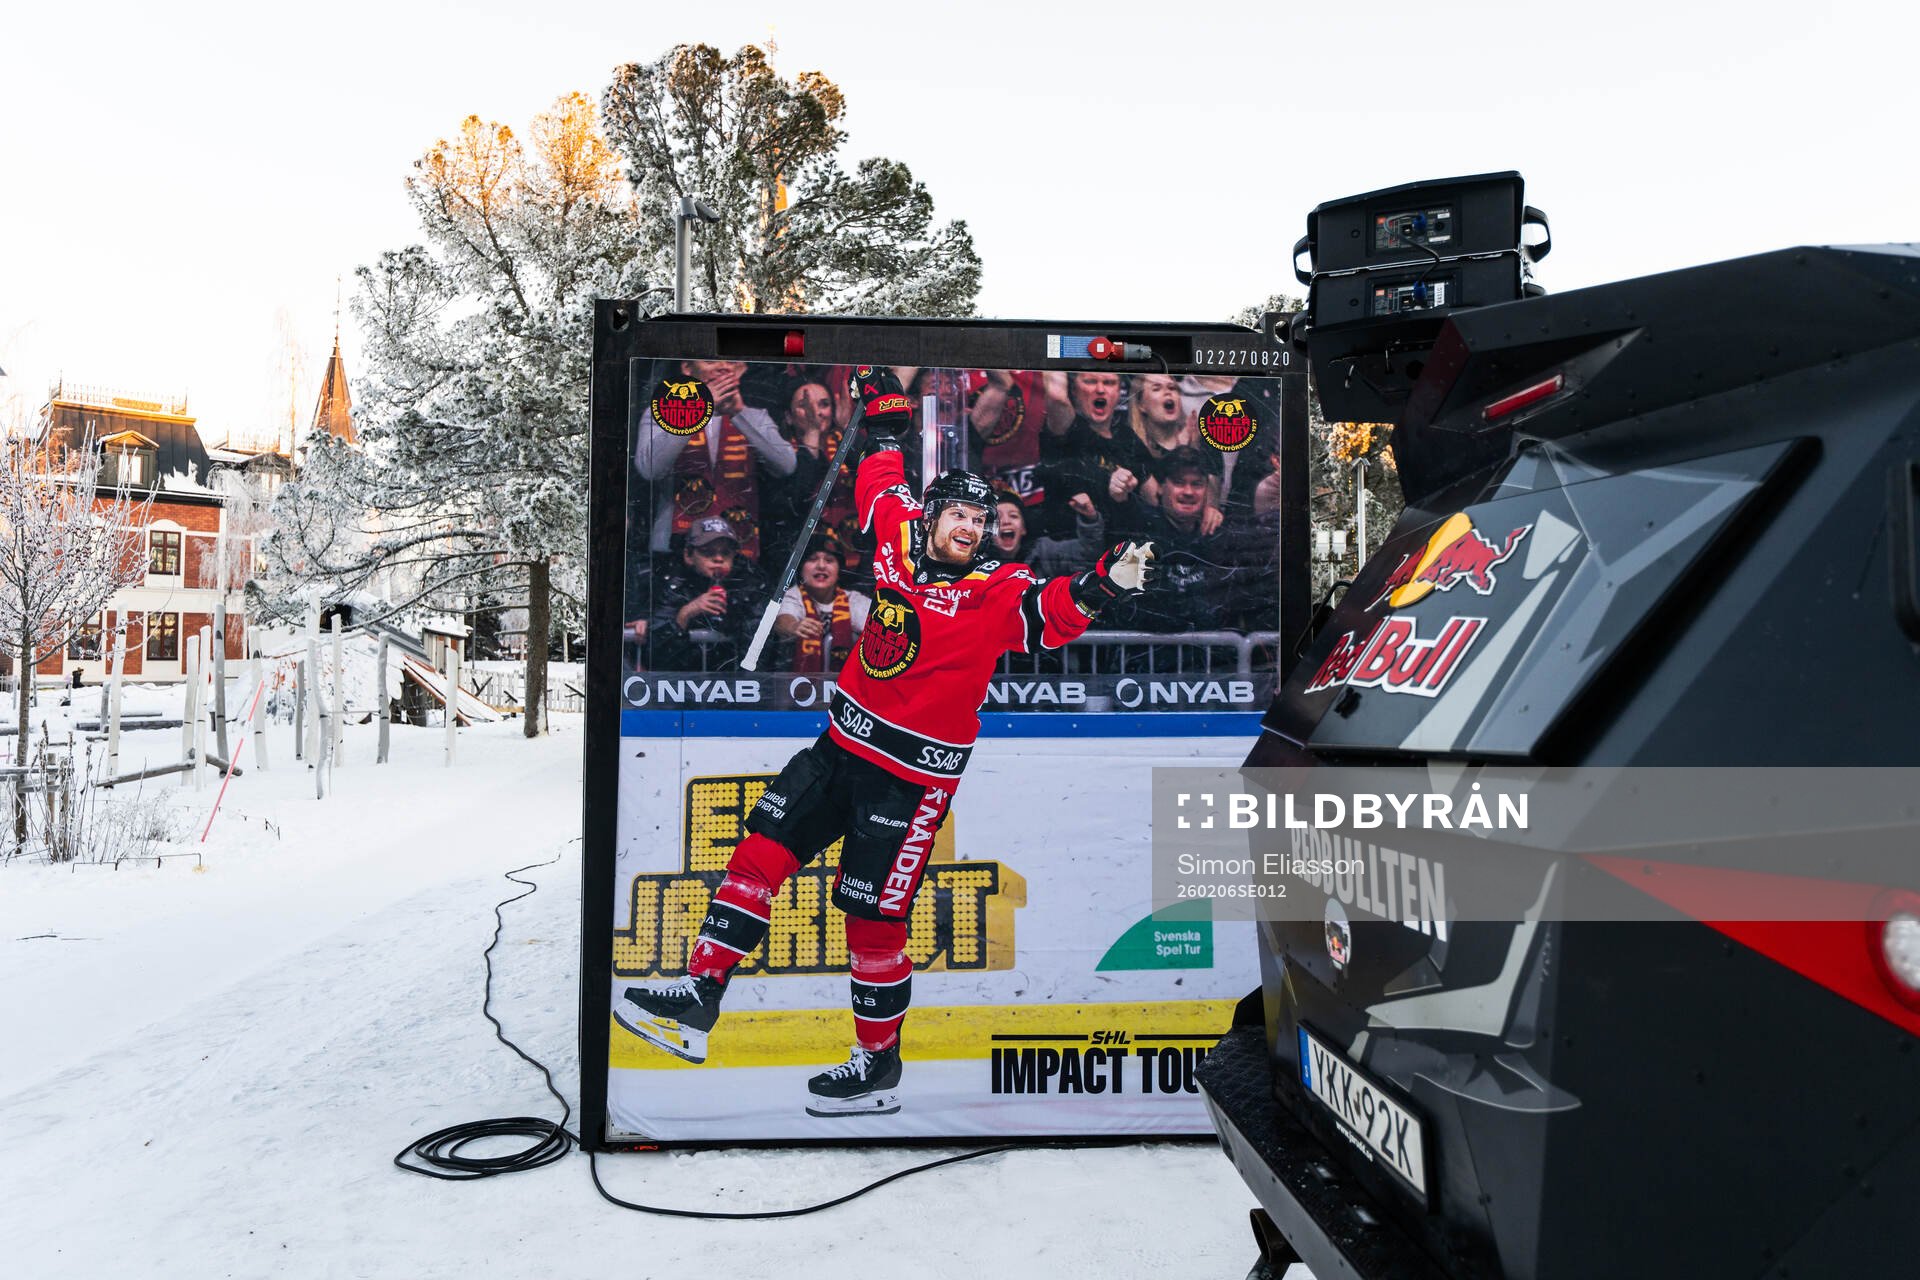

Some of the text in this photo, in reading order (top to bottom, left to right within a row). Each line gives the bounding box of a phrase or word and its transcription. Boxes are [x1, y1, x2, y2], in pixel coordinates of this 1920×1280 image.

[1195, 349, 1290, 366] 022270820
[905, 642, 918, 662] 1977
[1348, 616, 1488, 697] Bull
[657, 679, 761, 703] NYAB
[984, 681, 1086, 704] NYAB
[1150, 681, 1255, 704] NYAB
[840, 702, 874, 738] SSAB
[916, 745, 963, 770] SSAB
[842, 873, 874, 892] Luleå
[840, 884, 879, 905] Energi
[1154, 929, 1201, 942] Svenska
[1156, 943, 1201, 957] Spel Tur
[1091, 1030, 1132, 1044] SHL
[991, 1047, 1214, 1094] IMPACT TOU
[1313, 1043, 1356, 1126] YKK
[1361, 1086, 1413, 1178] 92K
